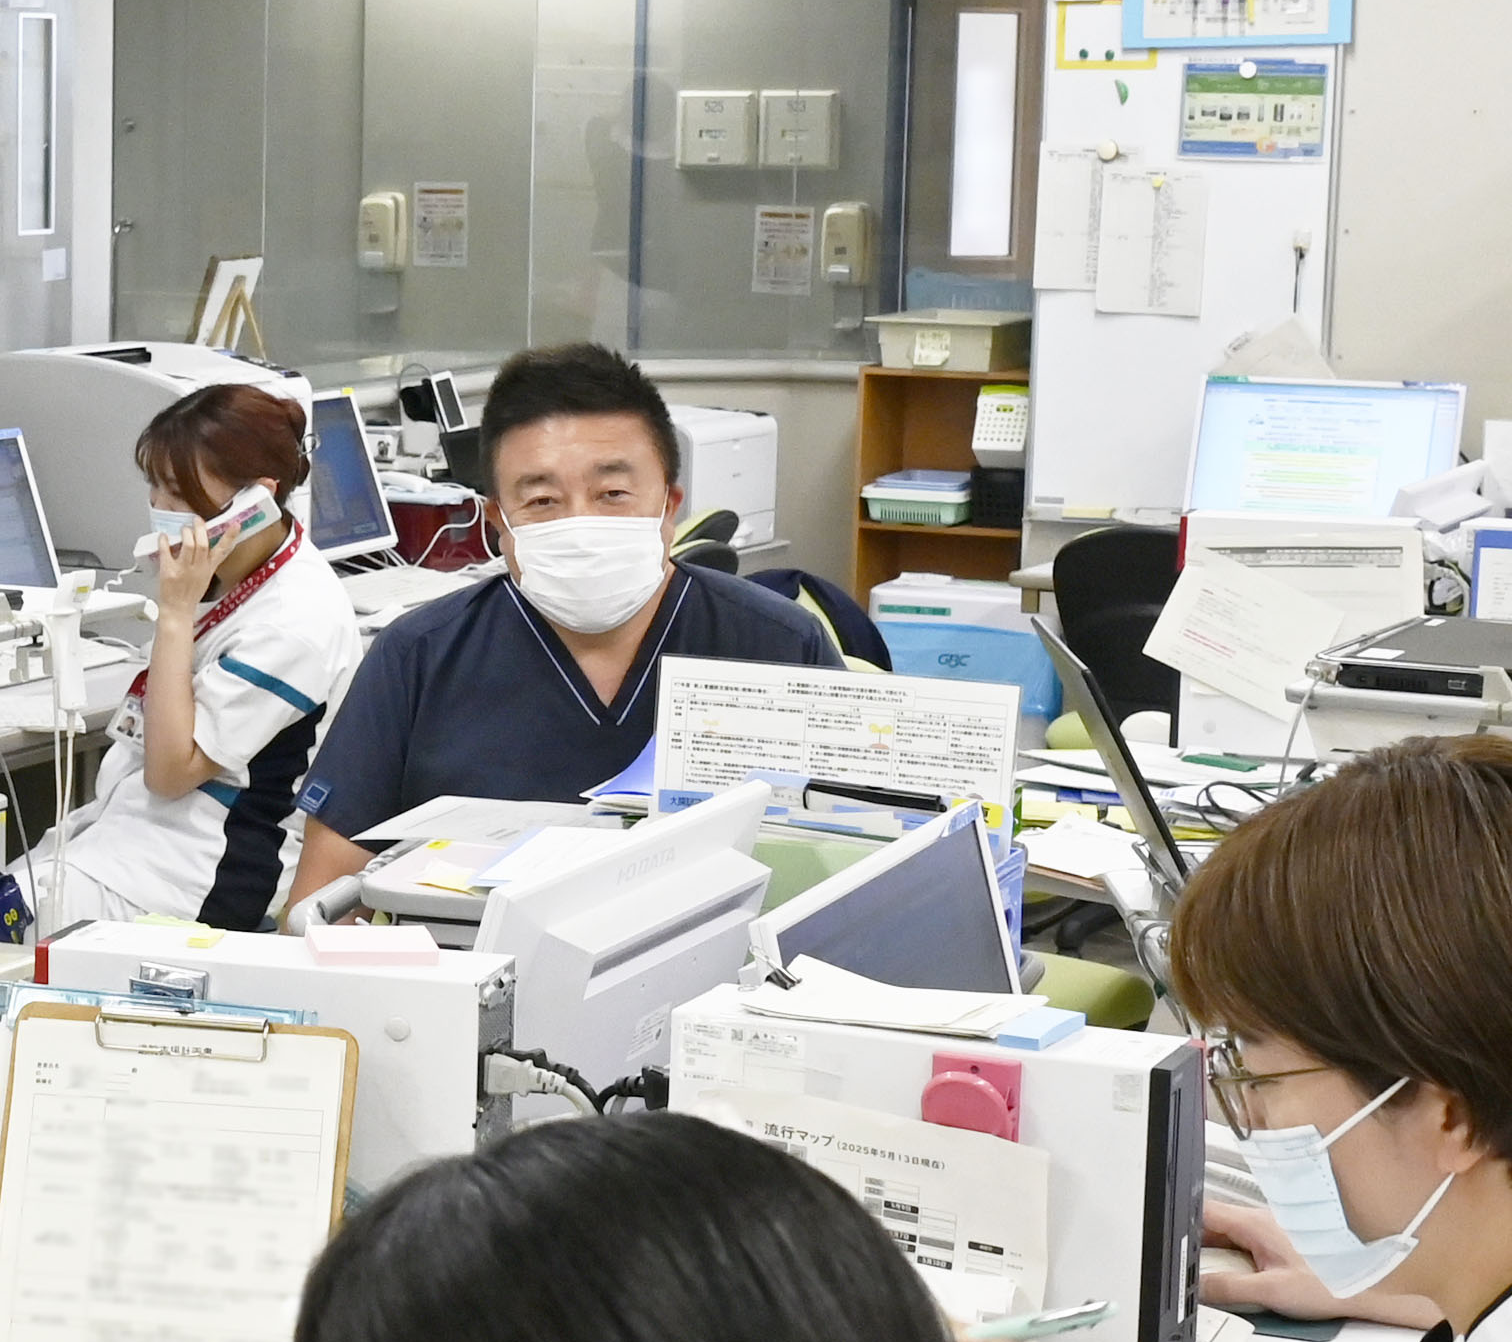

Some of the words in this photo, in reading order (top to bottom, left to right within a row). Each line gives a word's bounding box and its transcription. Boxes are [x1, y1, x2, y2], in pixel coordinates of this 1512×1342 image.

[938, 652, 972, 668] GBC
[764, 1122, 836, 1149] 流行マップ
